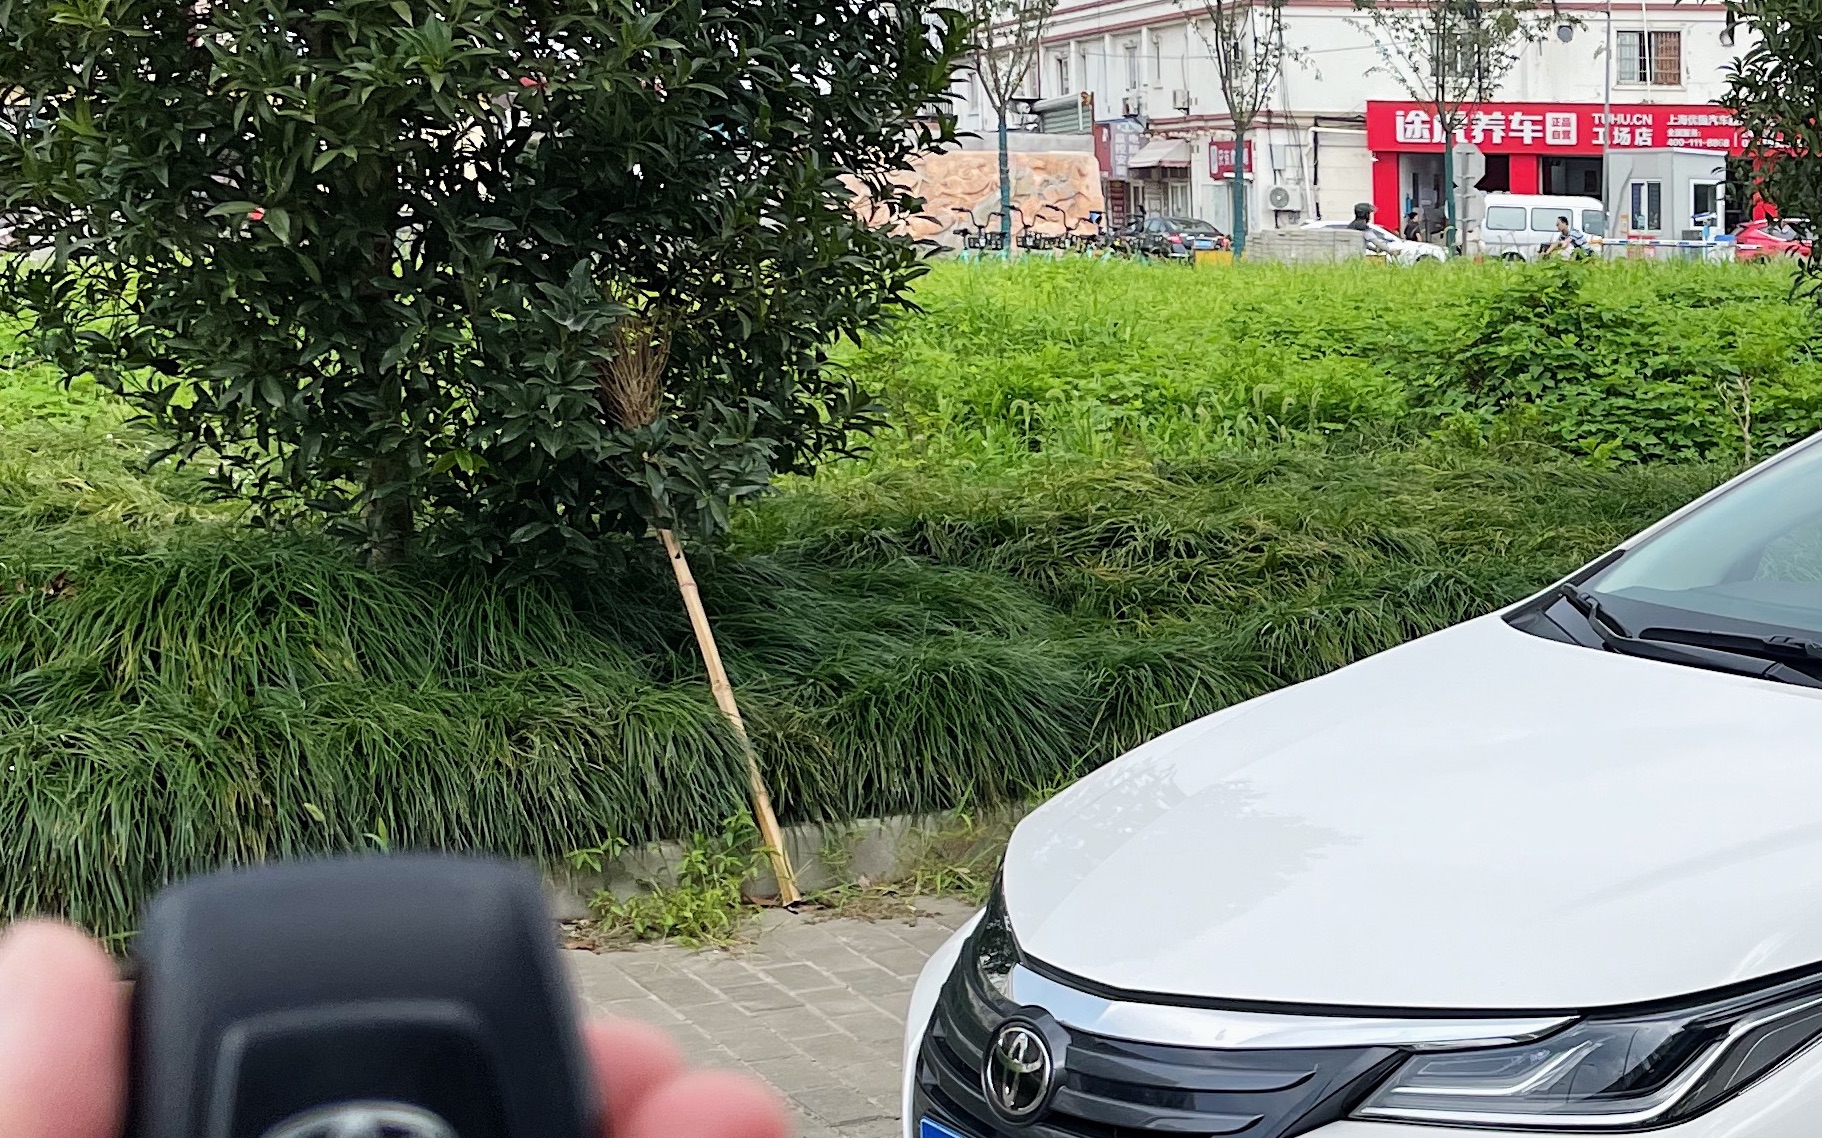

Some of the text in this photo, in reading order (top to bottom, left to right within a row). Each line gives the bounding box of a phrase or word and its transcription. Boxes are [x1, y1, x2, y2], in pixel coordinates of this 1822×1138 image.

[1395, 110, 1543, 144] 途虎养车
[1591, 127, 1653, 146] 工场店
